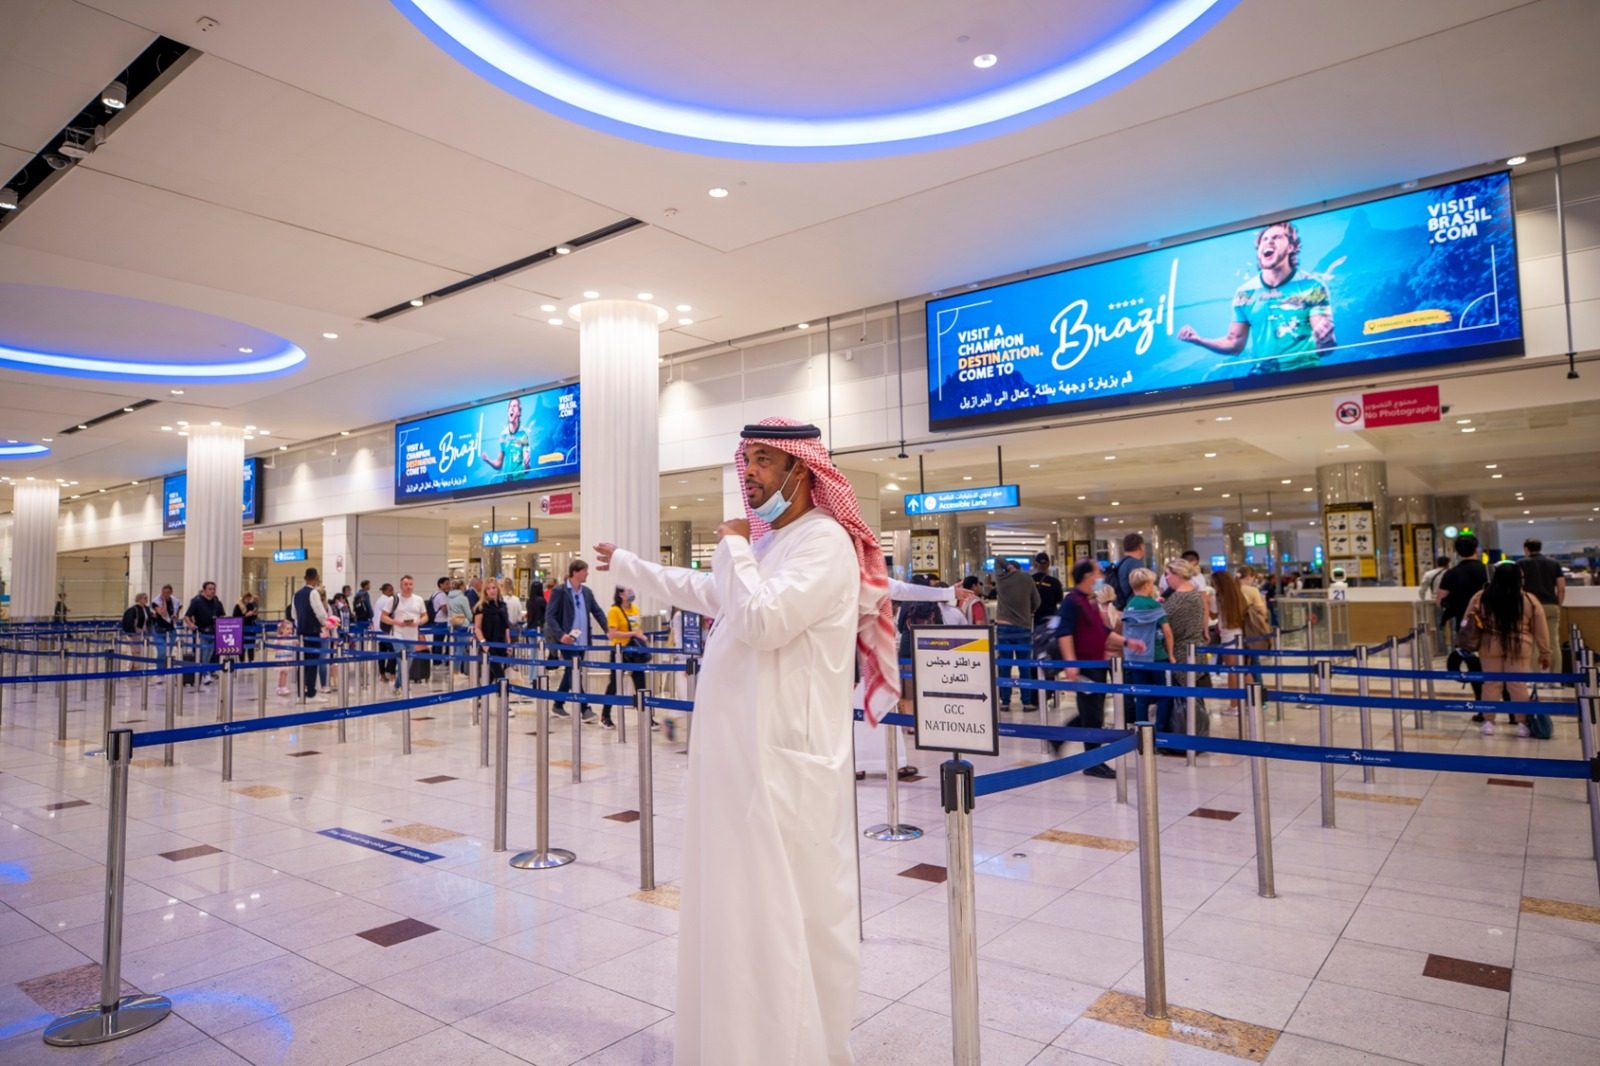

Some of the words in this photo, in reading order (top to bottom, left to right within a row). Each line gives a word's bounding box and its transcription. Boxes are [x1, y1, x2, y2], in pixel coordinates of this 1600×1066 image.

[1428, 196, 1476, 217] VISIT
[1428, 207, 1492, 232] BRASIL
[1428, 224, 1478, 244] .COM
[1050, 258, 1178, 370] Brazil
[958, 326, 990, 343] VISIT
[994, 324, 1004, 336] A
[958, 333, 1024, 356] CHAMPION
[958, 344, 1044, 370] DESTINATION.
[958, 366, 994, 382] COME
[996, 362, 1014, 376] TO
[1121, 370, 1133, 388] قم
[1058, 380, 1085, 394] وجهة
[1088, 375, 1118, 390] بزيارة
[960, 393, 992, 409] البرازيل
[1011, 388, 1029, 402] تعال
[1380, 405, 1439, 417] Photography
[439, 412, 483, 473] Brazil
[939, 500, 970, 510] Accessible
[1333, 590, 1345, 600] 21
[926, 657, 950, 668] مجلس
[954, 658, 981, 669] مواطنو
[942, 675, 968, 684] التعاون
[944, 704, 965, 715] GCC
[925, 720, 986, 734] NATIONALS
